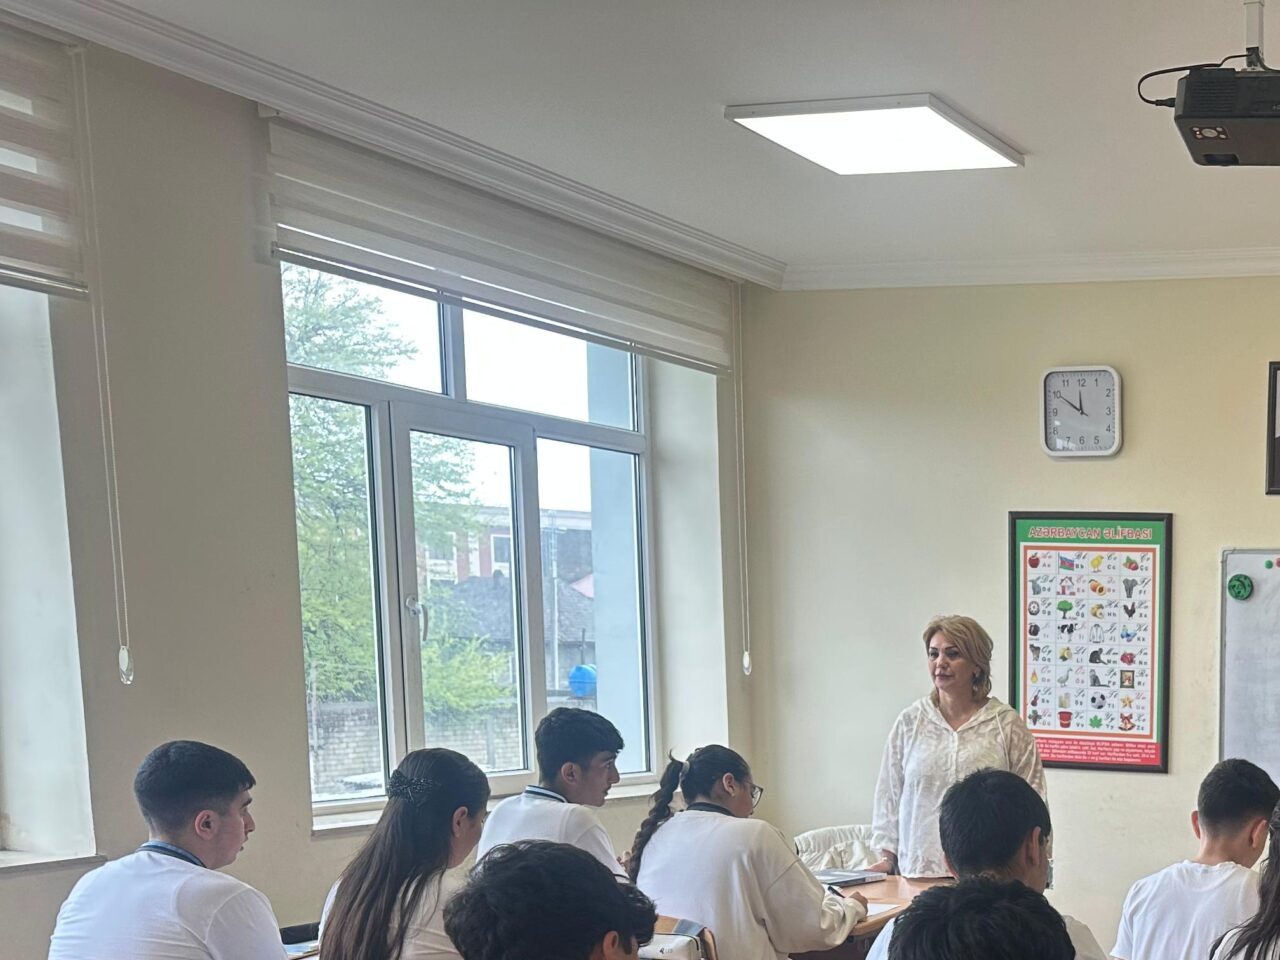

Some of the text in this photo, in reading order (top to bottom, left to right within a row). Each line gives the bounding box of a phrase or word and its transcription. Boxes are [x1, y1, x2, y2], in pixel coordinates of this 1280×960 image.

[1062, 379, 1070, 388] 11
[1077, 378, 1087, 388] 12
[1053, 390, 1062, 399] 10
[1105, 388, 1112, 398] 2
[1052, 407, 1058, 417] 9
[1105, 406, 1112, 416] 3
[1052, 426, 1059, 436] 8
[1079, 435, 1085, 445] 6
[1094, 435, 1100, 445] 5
[1028, 526, 1153, 540] AZƏRBAYCAN ƏLİFBASI
